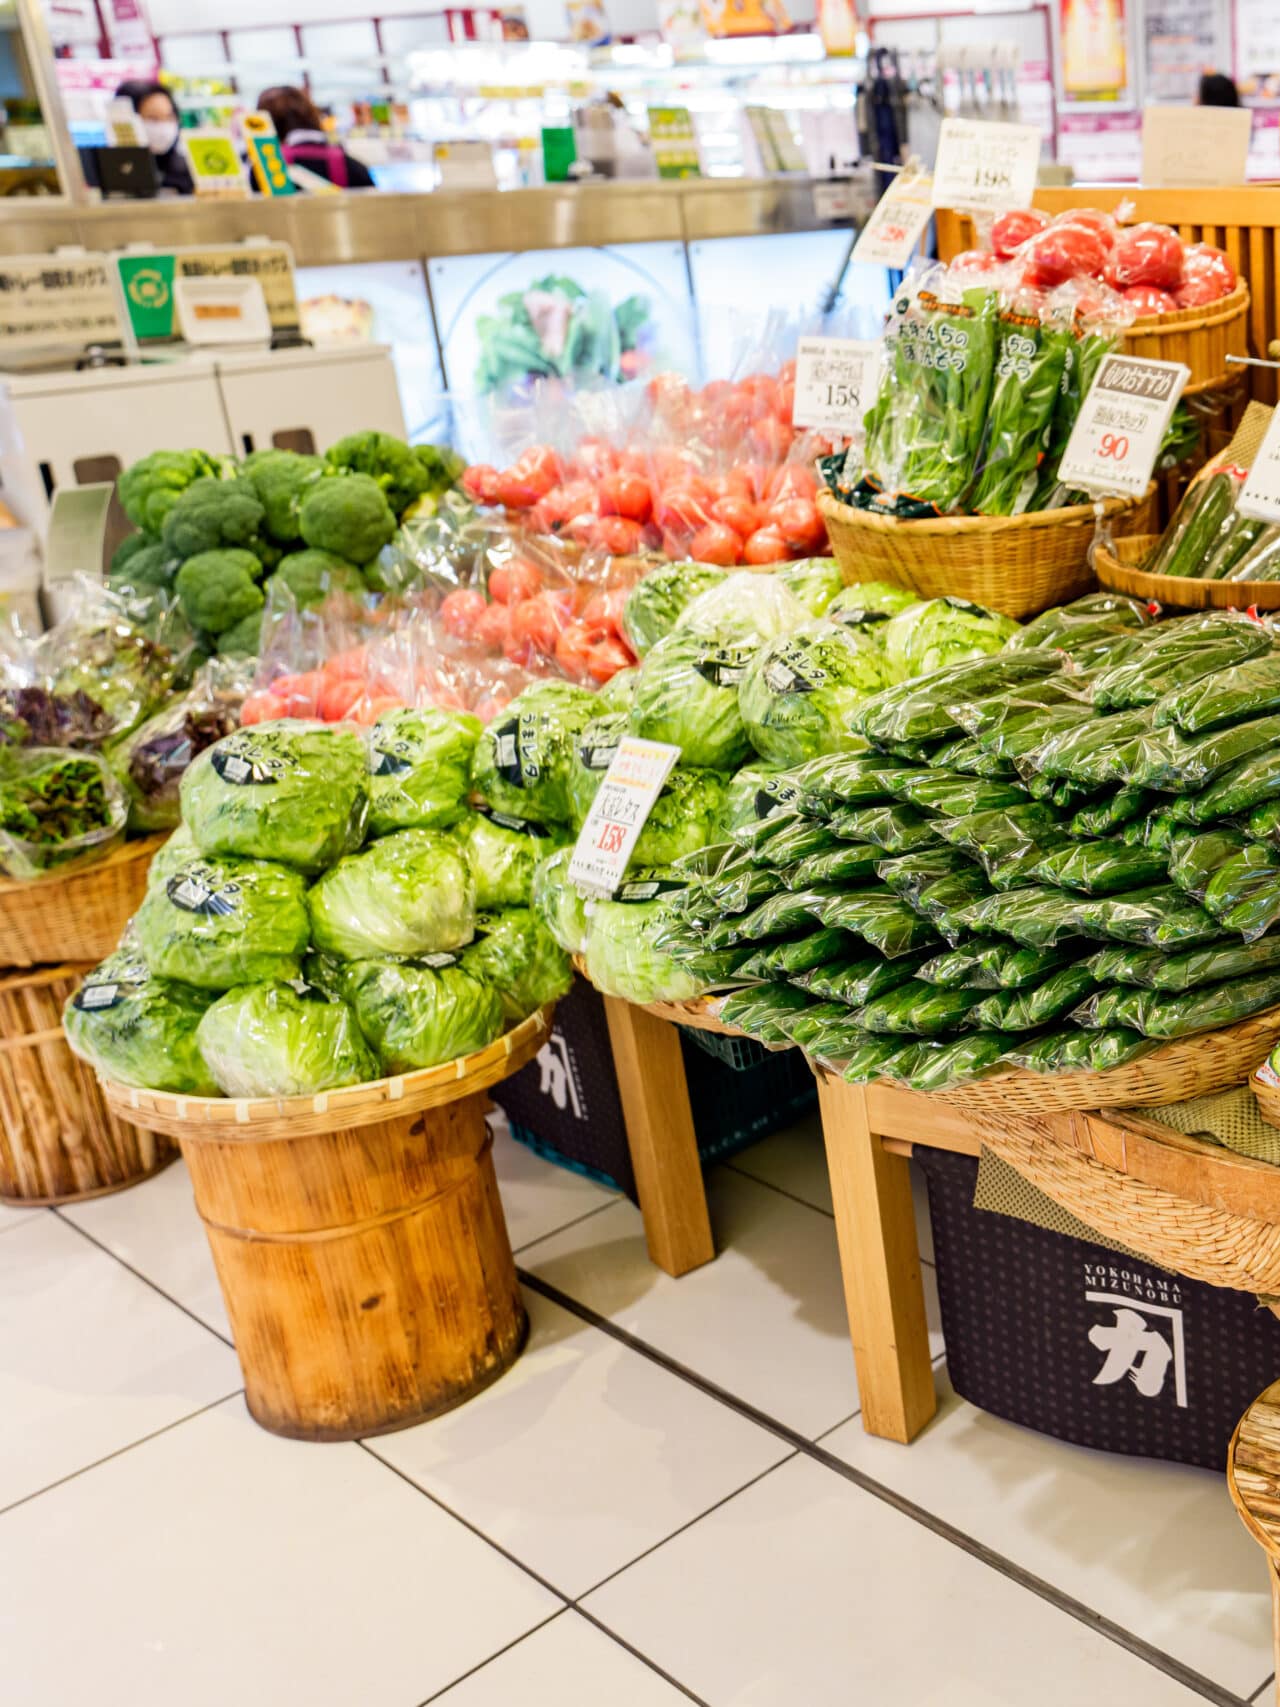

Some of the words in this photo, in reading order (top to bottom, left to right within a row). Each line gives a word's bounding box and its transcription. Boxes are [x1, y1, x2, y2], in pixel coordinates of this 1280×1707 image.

[827, 384, 860, 407] 158
[1084, 1263, 1181, 1293] YOKOHAMA
[1084, 1275, 1183, 1305] MIZUNOBU
